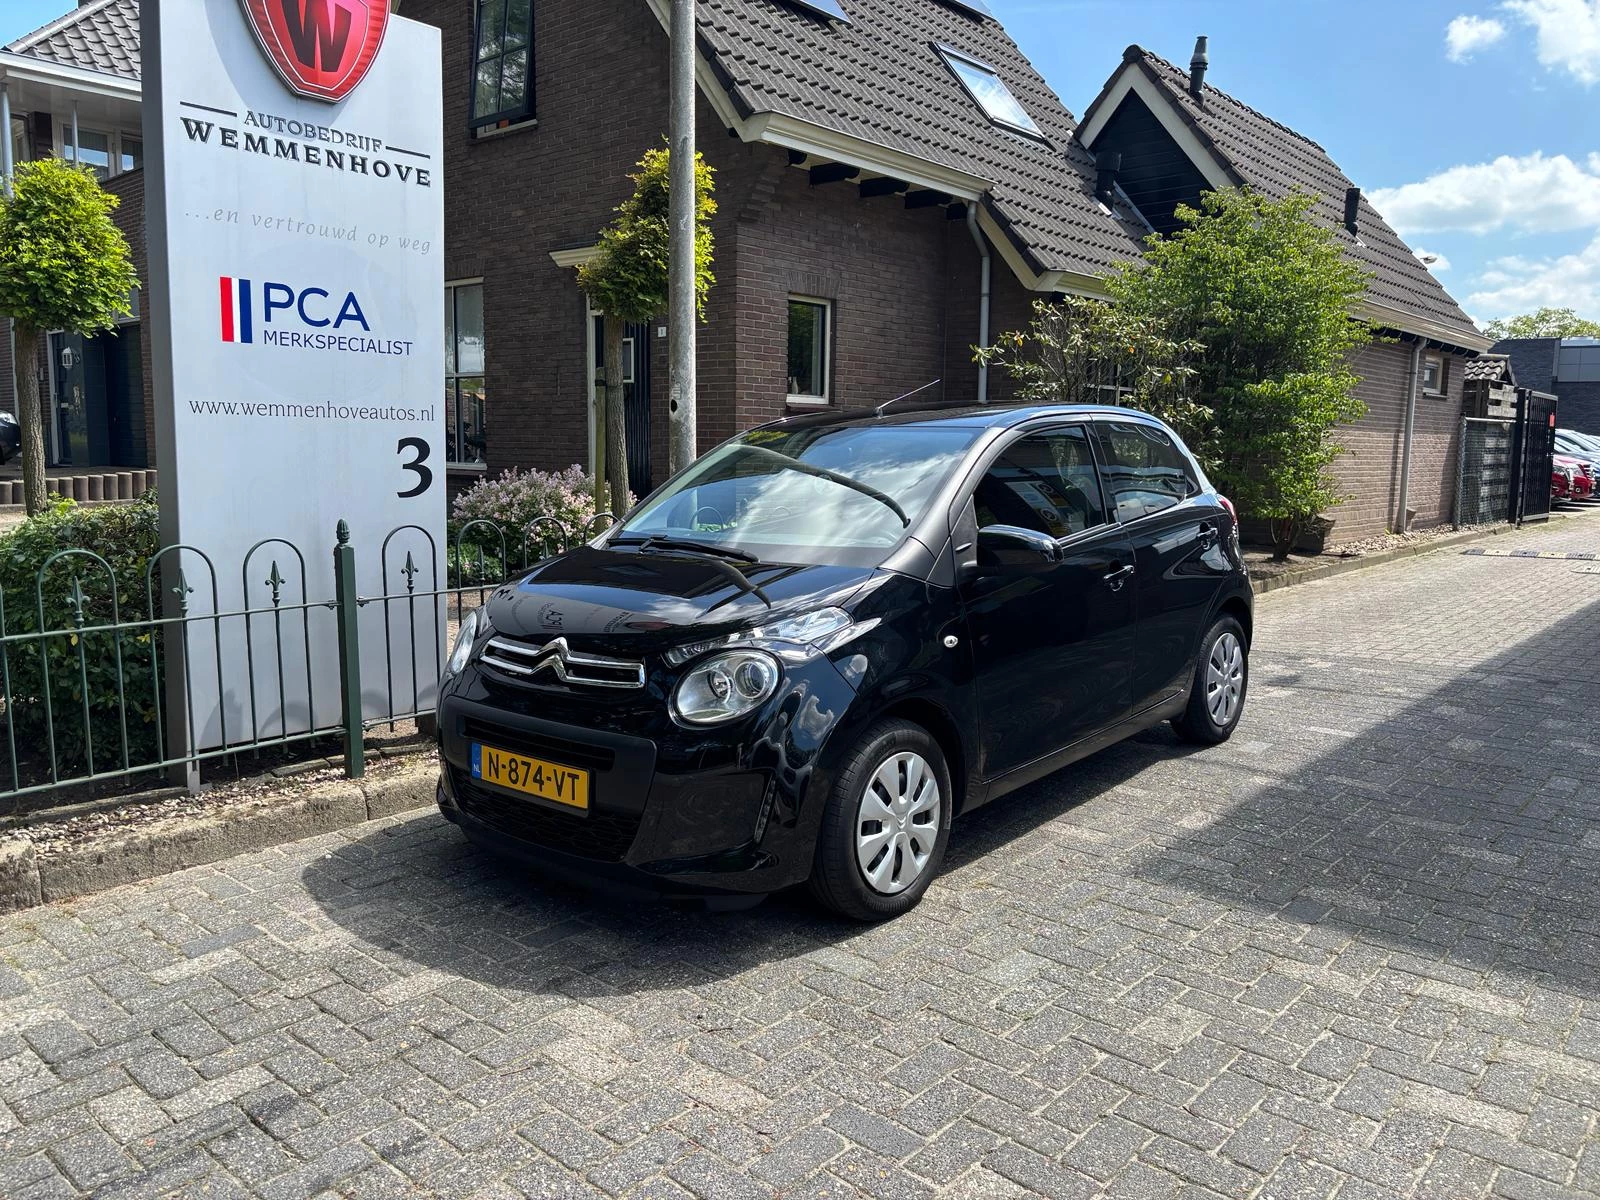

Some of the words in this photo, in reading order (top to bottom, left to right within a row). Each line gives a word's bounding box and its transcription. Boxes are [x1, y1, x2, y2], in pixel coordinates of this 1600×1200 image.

[180, 116, 431, 187] WEMMENHOVE
[244, 110, 383, 153] AUTOBEDRIJF
[251, 212, 357, 241] vertrouwd
[367, 232, 389, 248] op
[399, 236, 431, 255] weg
[263, 282, 370, 331] PCA
[263, 330, 413, 356] MERKSPECIALIST
[189, 400, 435, 421] www.wemmenhoveautos.nl
[396, 436, 433, 499] 3
[488, 751, 580, 801] N-874-VT
